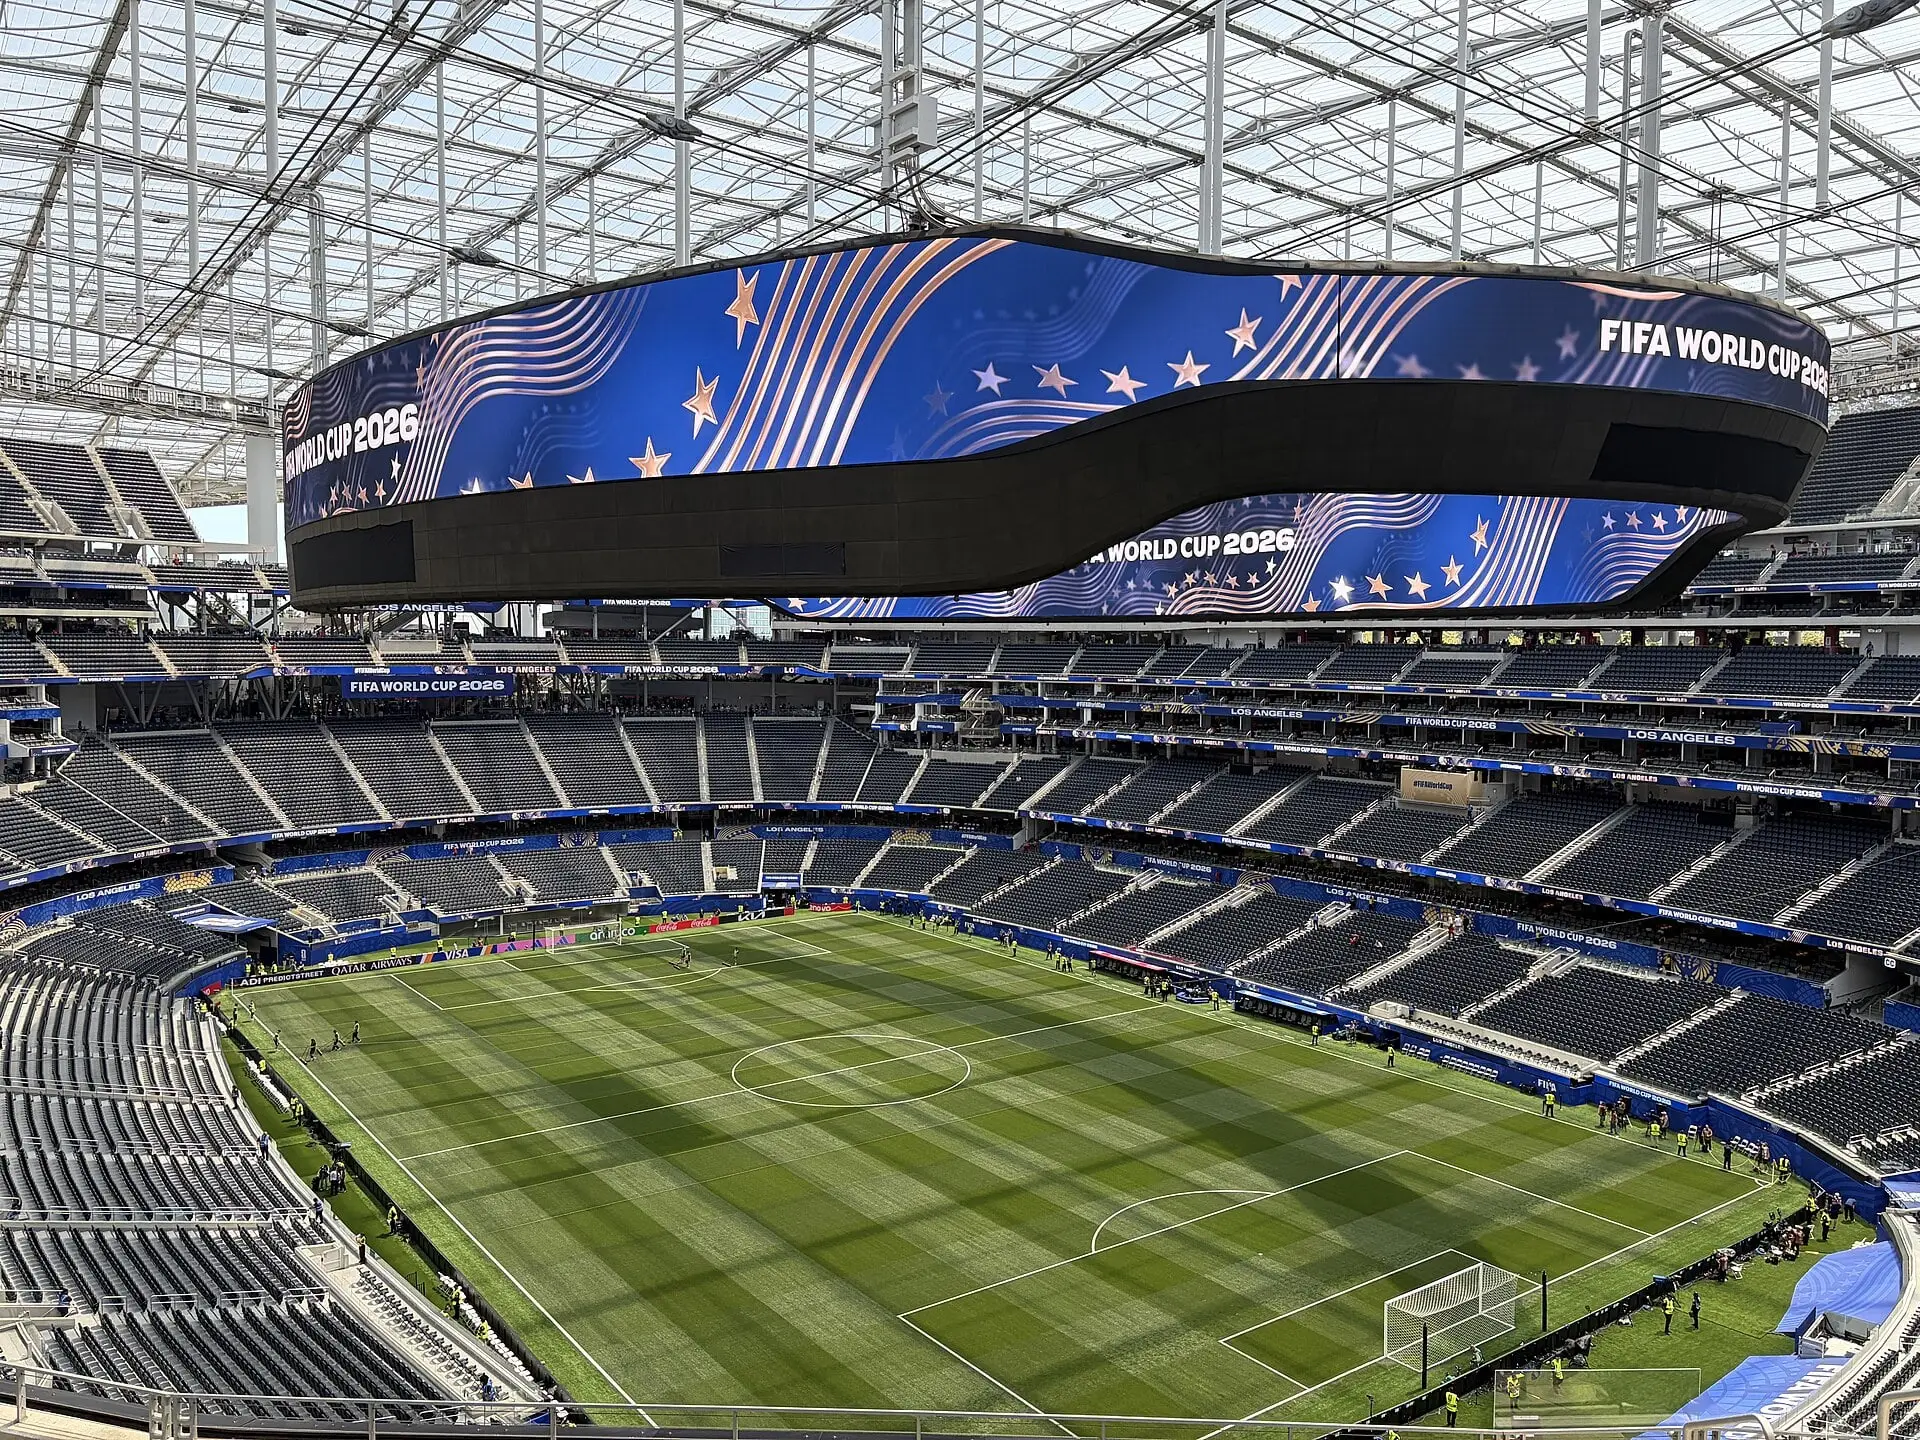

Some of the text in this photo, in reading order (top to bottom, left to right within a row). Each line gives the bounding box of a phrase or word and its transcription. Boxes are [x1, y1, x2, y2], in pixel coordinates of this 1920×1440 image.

[1600, 318, 1828, 398] FIFA WORLD CUP 2026
[294, 433, 324, 476] WORLD
[327, 422, 352, 462] CUP
[354, 404, 418, 452] 2026
[1108, 538, 1178, 562] WORLD
[1181, 535, 1220, 558] CUP
[1224, 528, 1296, 556] 2026
[402, 604, 464, 612] ANGELES
[350, 680, 505, 693] FIFA WORLD CUP 2026
[1254, 710, 1302, 718] ANGELES
[1423, 718, 1450, 727] WORLD
[1628, 730, 1736, 744] LOS ANGELES
[1753, 785, 1778, 794] WORLD
[1780, 787, 1794, 795] CUP
[1796, 790, 1822, 798] 2026
[460, 841, 485, 849] WORLD
[1157, 859, 1177, 867] WORLD
[1191, 864, 1211, 872] 2026
[76, 883, 141, 901] LOS ANGELES
[1555, 890, 1583, 900] ANGELES
[1658, 909, 1737, 928] FIFA WORLD CUP 2026
[1517, 922, 1617, 949] FIFA WORLD CUP 2026
[445, 948, 469, 960] VISA
[1827, 940, 1883, 956] LOS ANGELES
[331, 957, 412, 976] QATAR AIRWAYS
[240, 977, 261, 986] ADI
[1621, 1084, 1640, 1096] WORLD
[1640, 1090, 1652, 1099] CUP
[1786, 1364, 1845, 1392] FIFA
